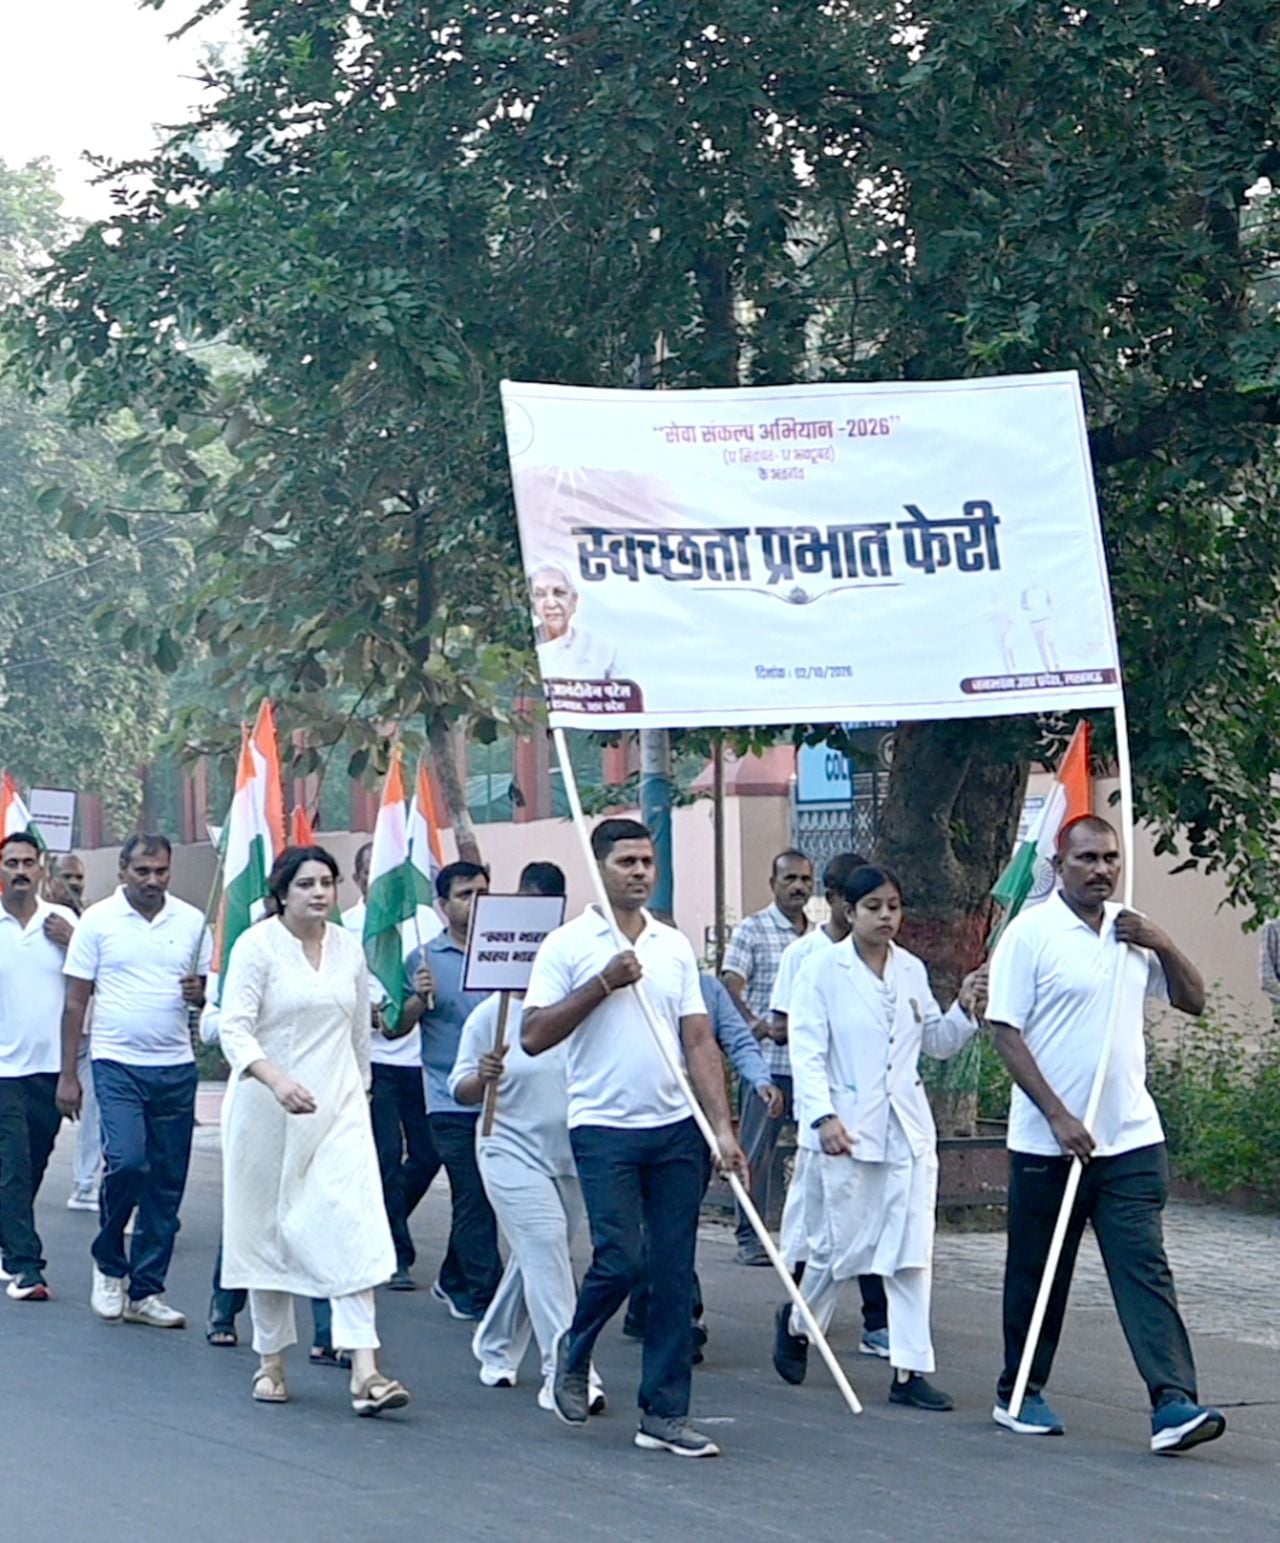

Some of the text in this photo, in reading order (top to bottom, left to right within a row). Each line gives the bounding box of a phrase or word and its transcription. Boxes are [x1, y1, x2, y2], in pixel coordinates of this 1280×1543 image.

[759, 416, 834, 441] अभियान
[571, 500, 1001, 585] स्वच्छता प्रभात फेरी
[603, 681, 631, 698] पटेल
